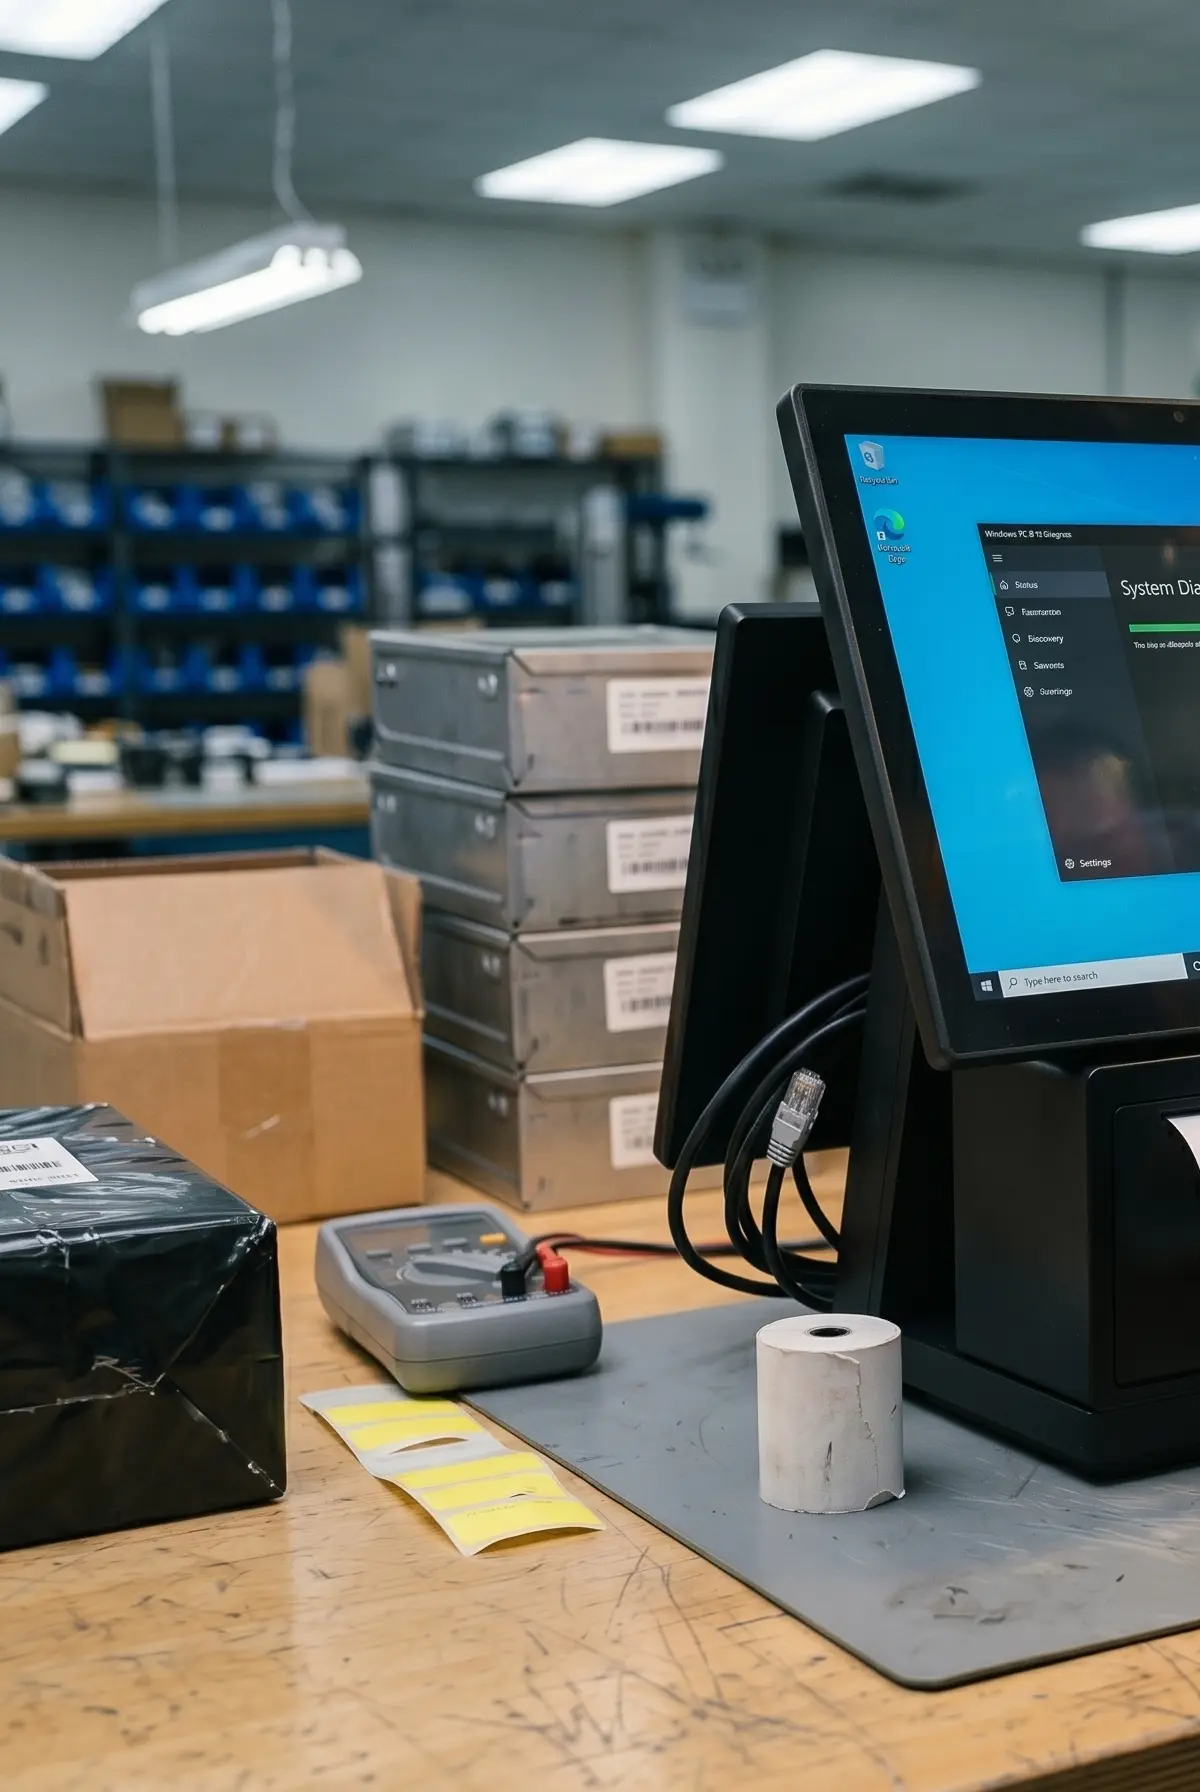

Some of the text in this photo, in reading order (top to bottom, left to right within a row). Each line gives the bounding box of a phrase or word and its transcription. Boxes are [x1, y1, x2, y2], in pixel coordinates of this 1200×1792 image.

[984, 530, 1017, 538] Windows
[1120, 579, 1175, 600] System
[1079, 858, 1112, 869] Settings
[1024, 977, 1043, 989] Type
[1043, 975, 1062, 985] here
[1062, 974, 1072, 983] to
